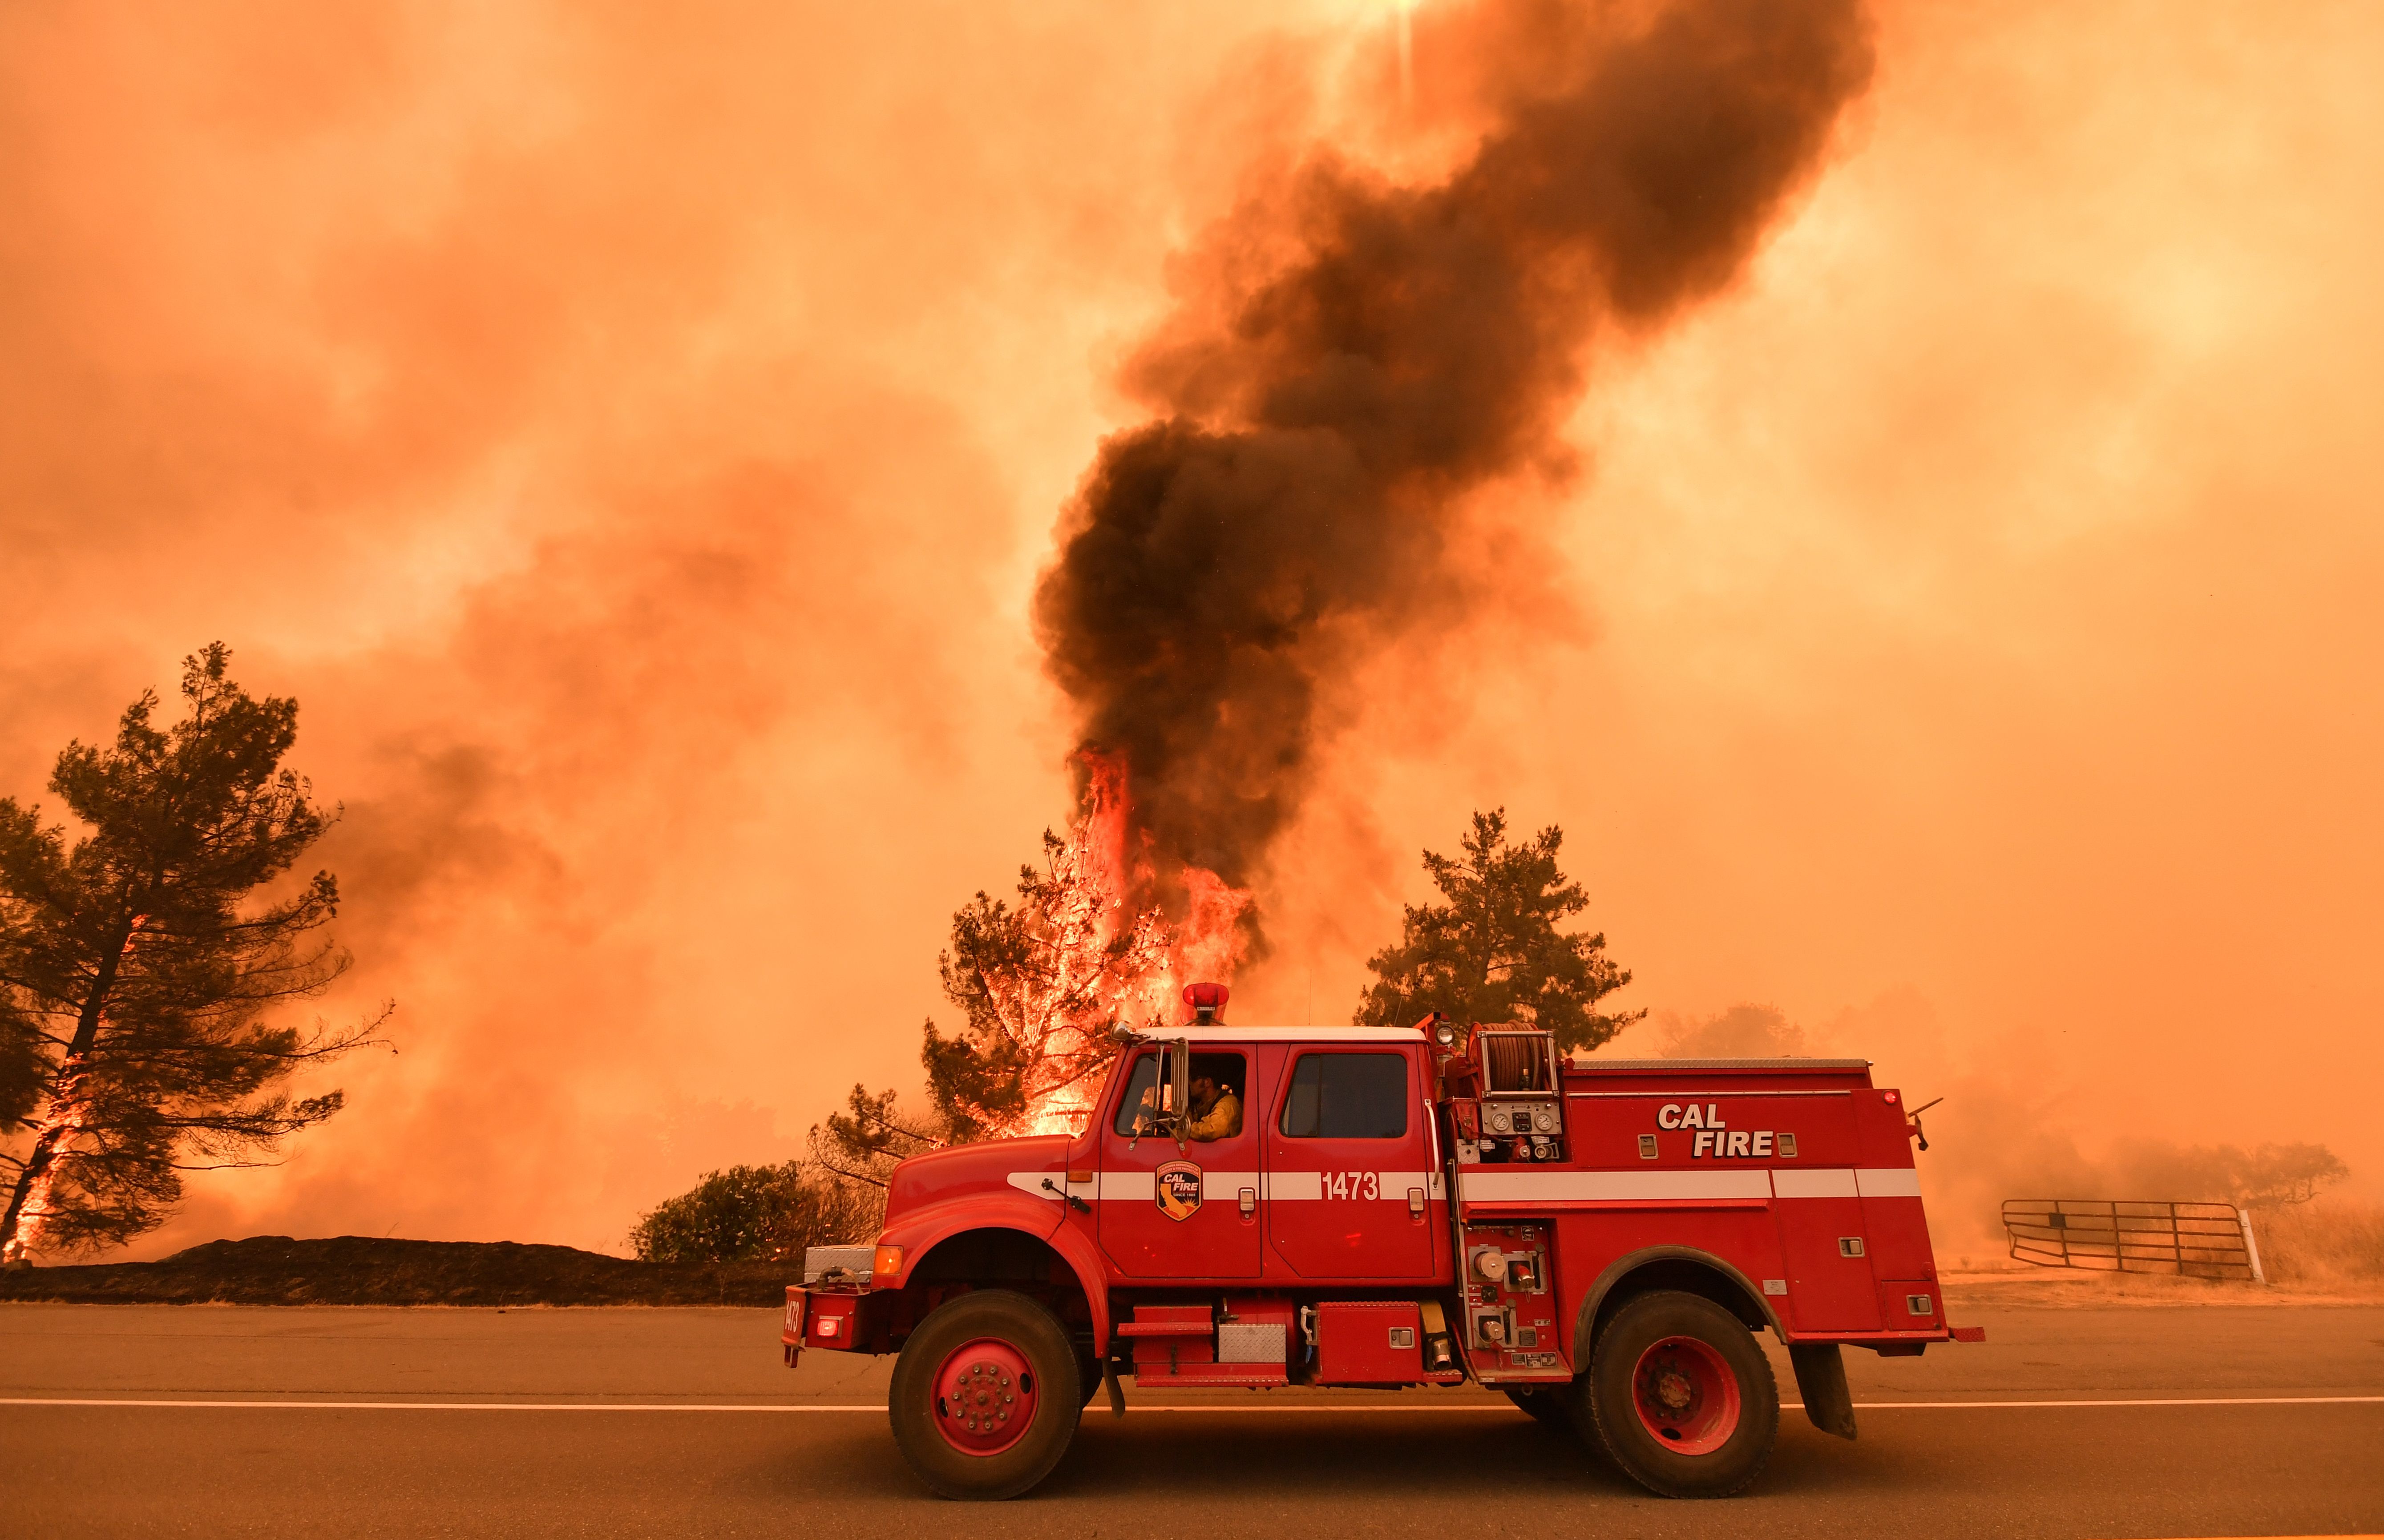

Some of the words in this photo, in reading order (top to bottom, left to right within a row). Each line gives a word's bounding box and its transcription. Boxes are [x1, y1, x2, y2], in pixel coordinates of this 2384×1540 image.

[1657, 1104, 1726, 1130] CAL
[1693, 1131, 1774, 1157] FIRE
[1164, 1174, 1185, 1182] CAL
[1173, 1182, 1198, 1191] FIRE
[1322, 1171, 1378, 1201] 1473
[785, 1300, 800, 1333] 1473
